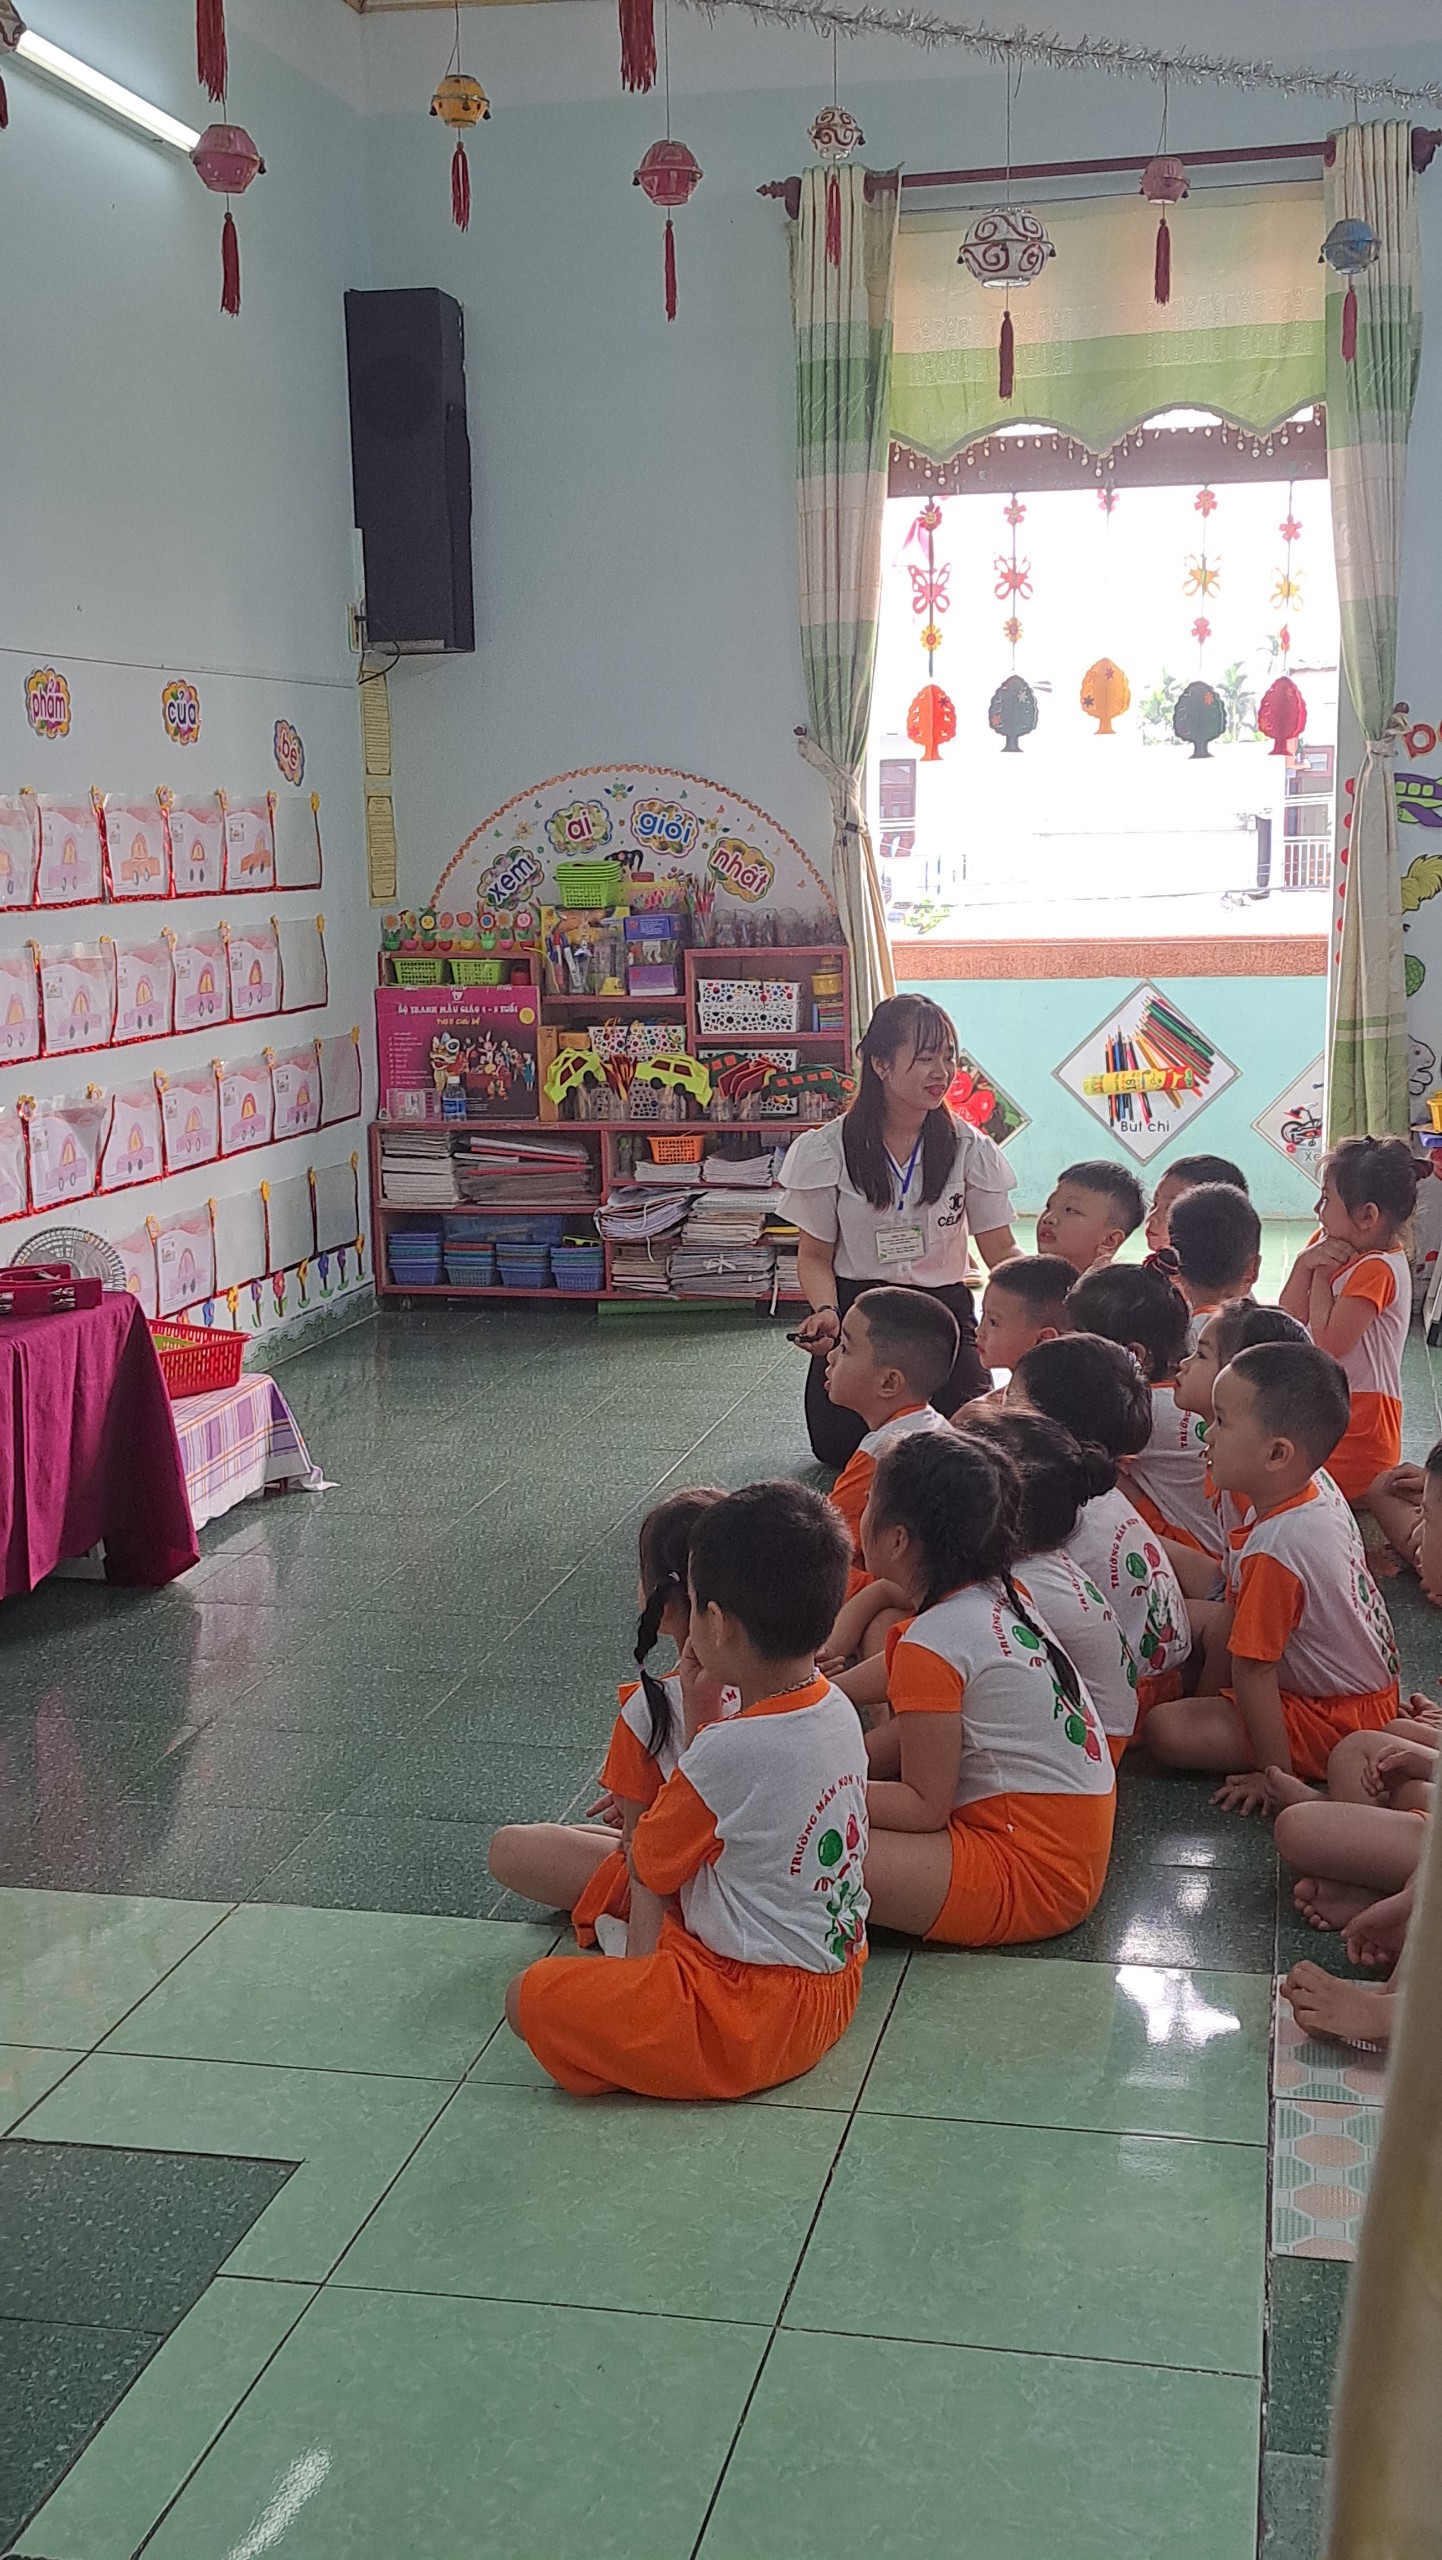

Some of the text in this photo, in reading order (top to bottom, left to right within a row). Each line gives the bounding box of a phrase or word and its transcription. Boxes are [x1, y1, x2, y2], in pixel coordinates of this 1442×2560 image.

[168, 690, 197, 725] của
[282, 732, 298, 767] bé
[488, 810, 770, 905] xem ai giỏi nhất
